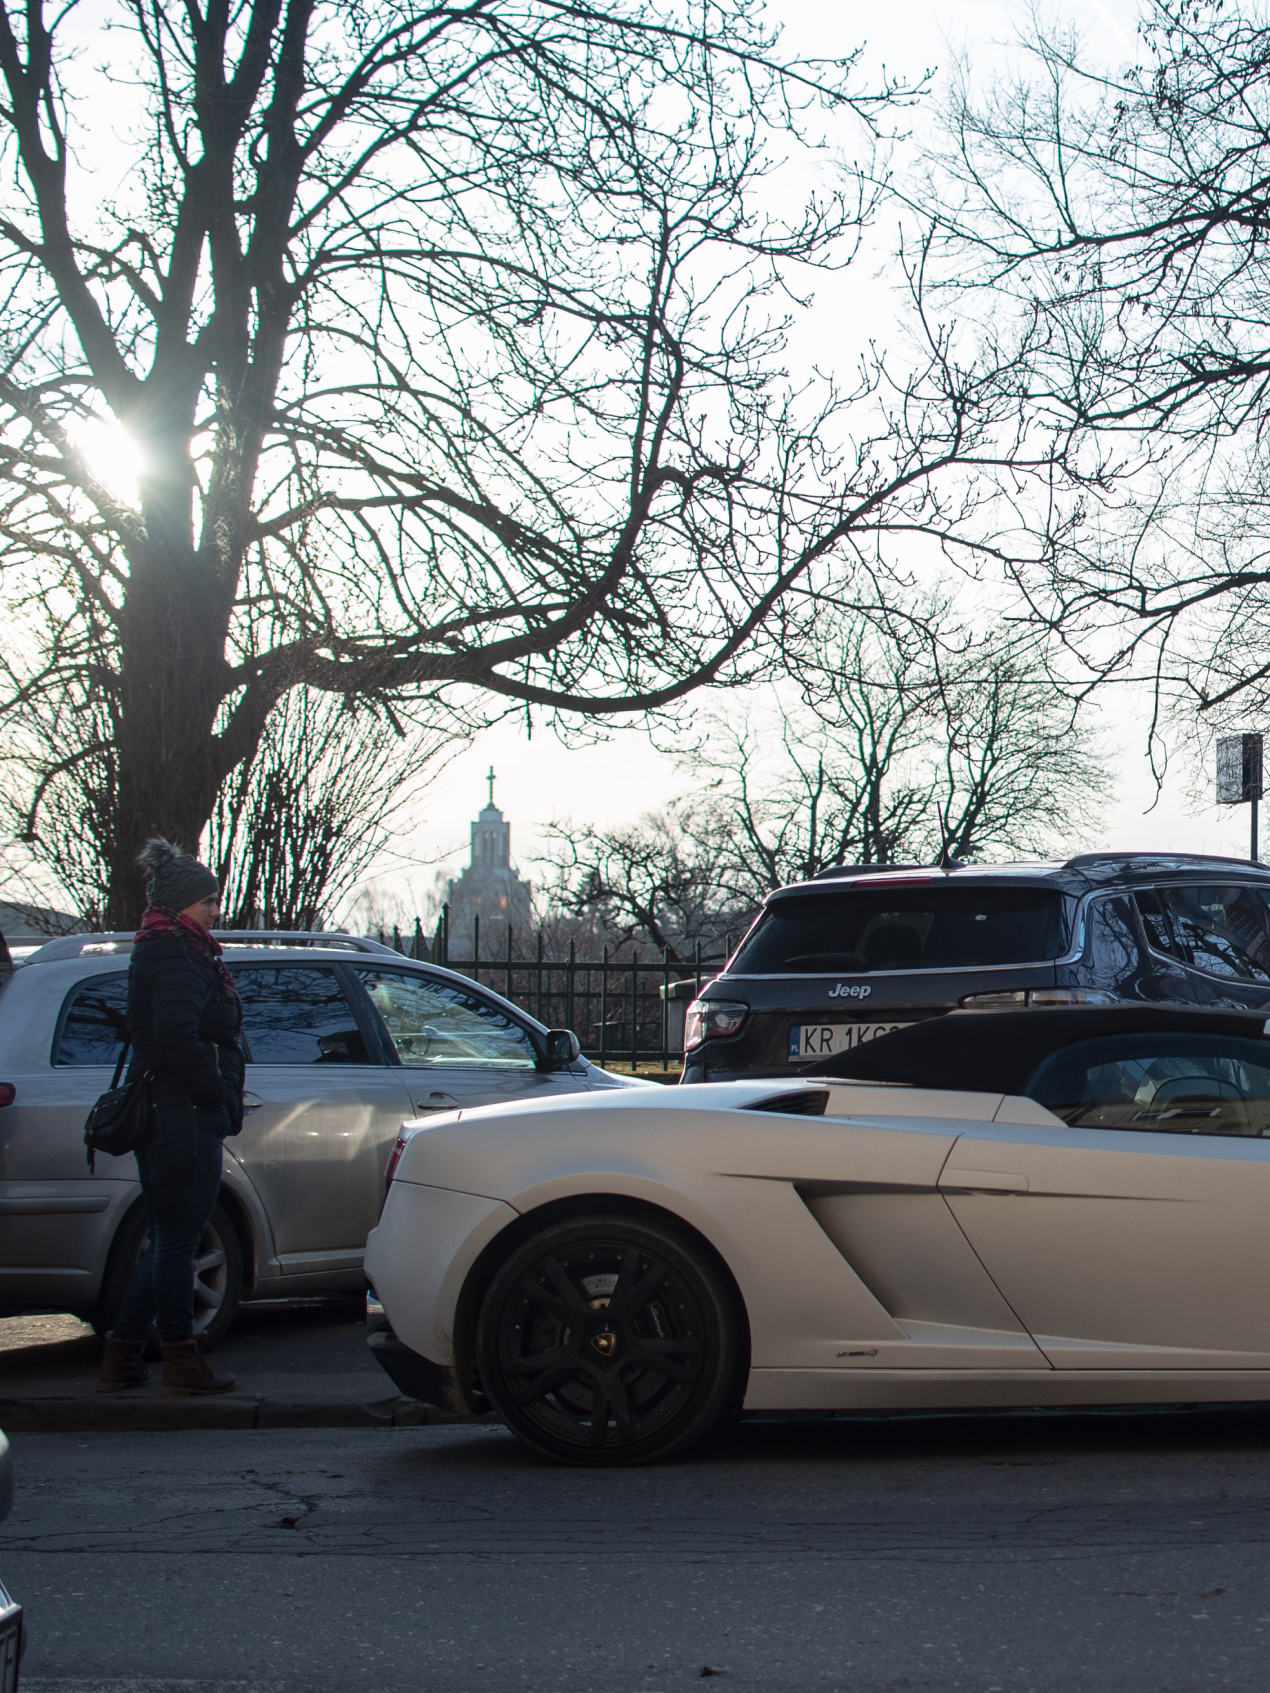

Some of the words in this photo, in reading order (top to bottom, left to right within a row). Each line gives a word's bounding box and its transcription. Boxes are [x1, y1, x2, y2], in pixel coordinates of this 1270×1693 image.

[828, 983, 872, 999] Jeep
[791, 1044, 799, 1052] PL
[805, 1026, 834, 1054] KR
